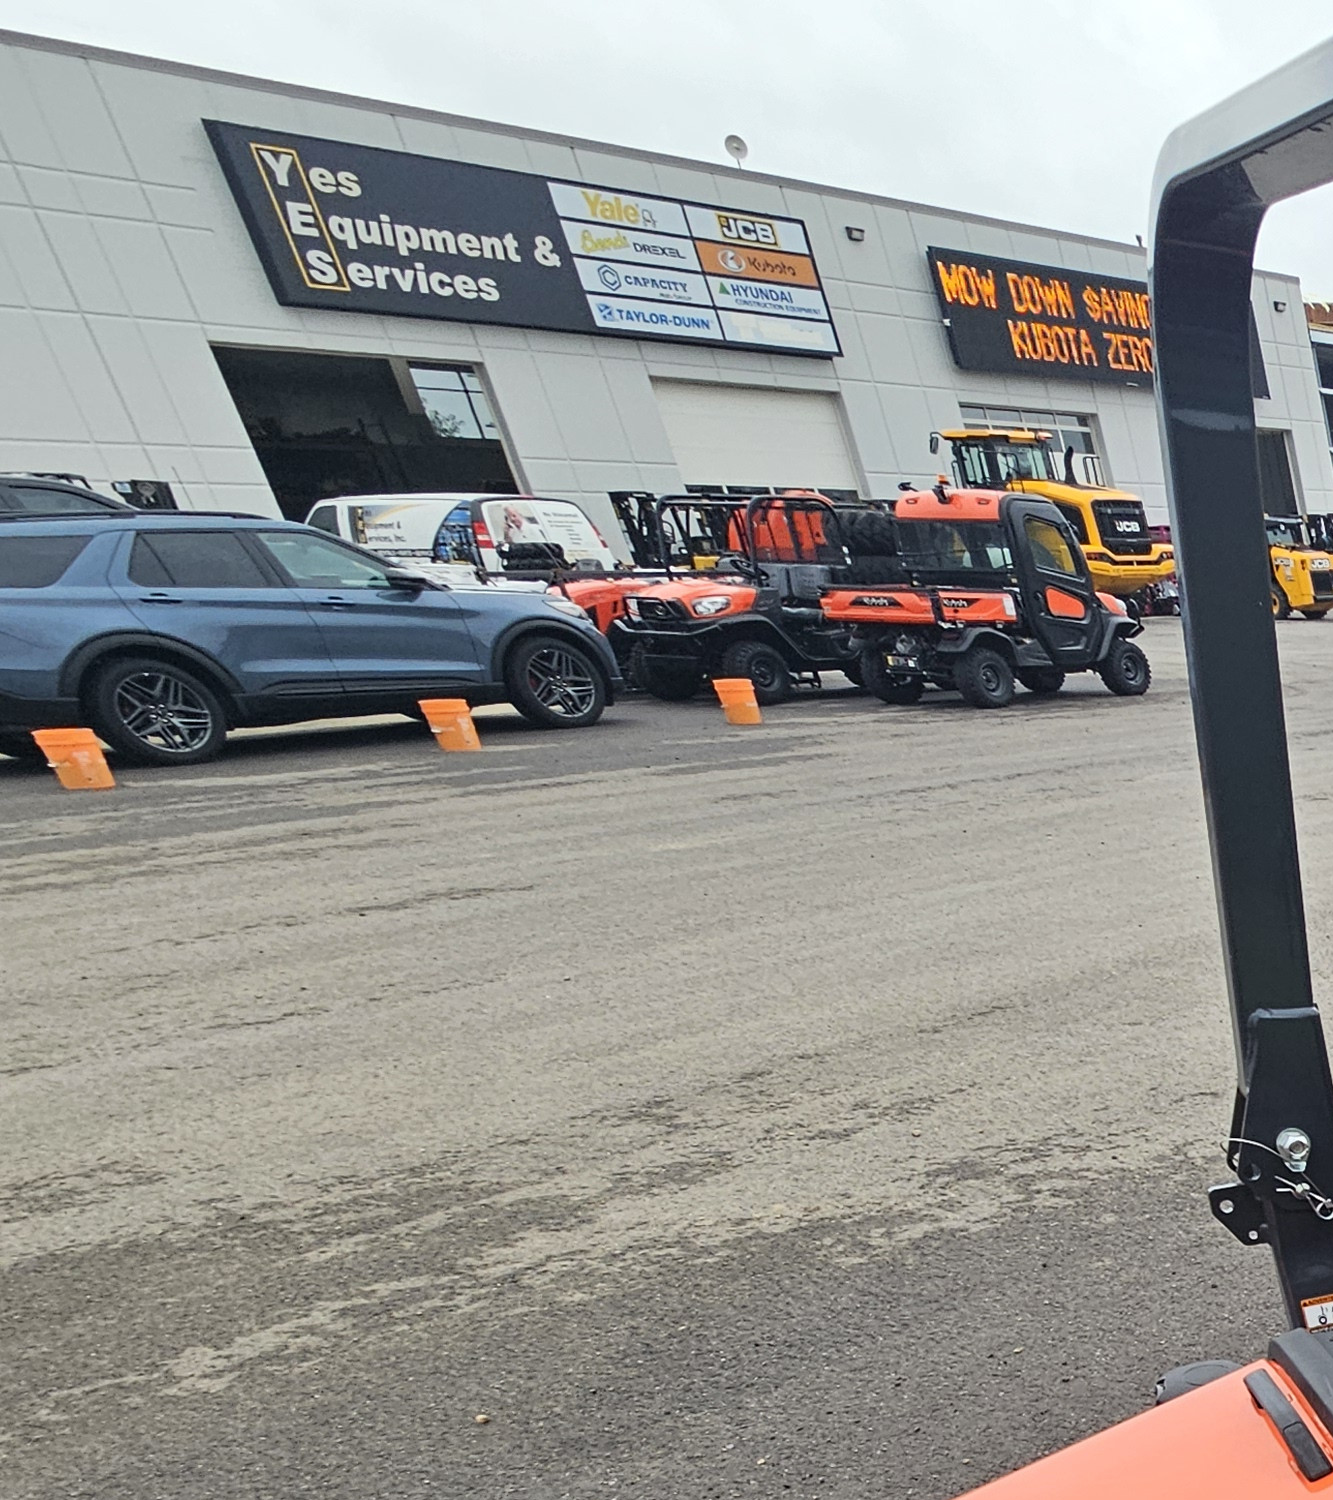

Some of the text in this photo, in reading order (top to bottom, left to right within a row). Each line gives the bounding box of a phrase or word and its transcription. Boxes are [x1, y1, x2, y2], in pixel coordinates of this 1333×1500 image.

[258, 150, 362, 197] Yes
[580, 190, 640, 224] Yale
[285, 201, 562, 268] Equipment &
[721, 217, 777, 244] JCB
[632, 241, 687, 259] DREXEL
[305, 249, 500, 301] Services
[746, 256, 797, 277] Kubota
[624, 275, 688, 292] CAPACITY
[730, 283, 794, 304] HYUNDAI
[936, 260, 997, 309] MOW
[1006, 271, 1075, 319] DOWN
[617, 308, 711, 330] TAYLOR-DUNN
[1007, 319, 1098, 367] KUBOTA
[1114, 520, 1140, 532] JCB
